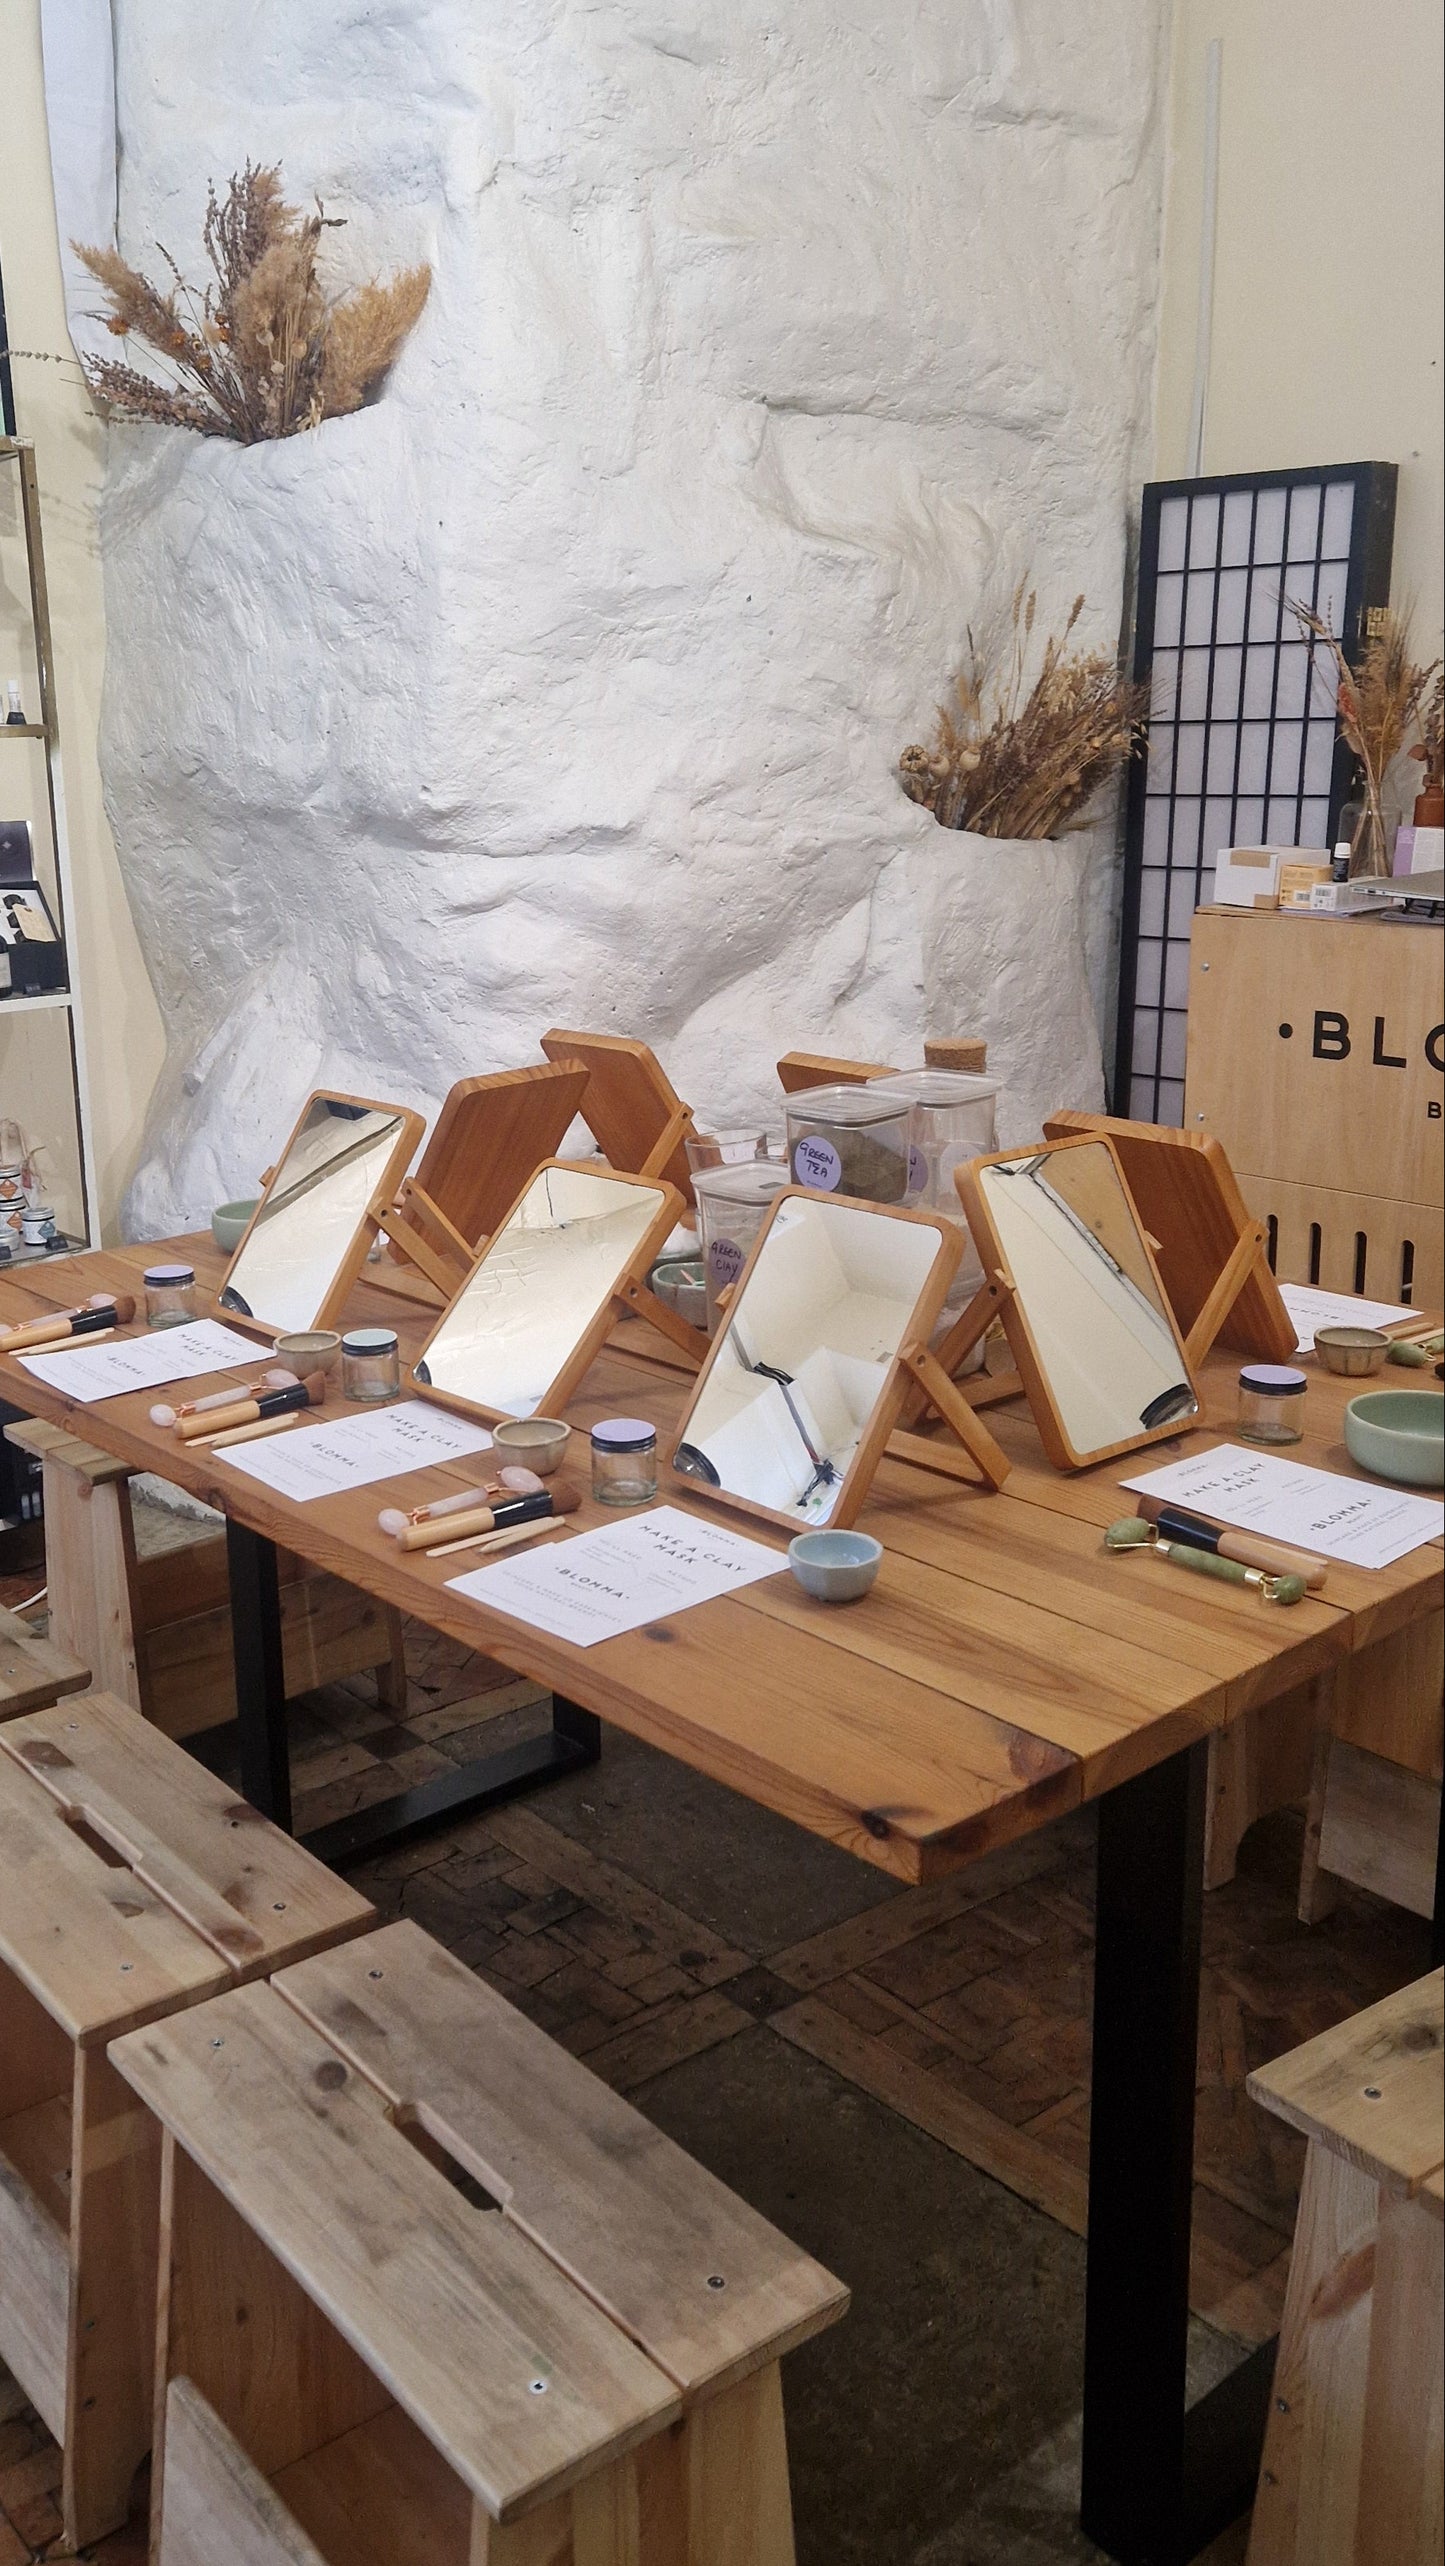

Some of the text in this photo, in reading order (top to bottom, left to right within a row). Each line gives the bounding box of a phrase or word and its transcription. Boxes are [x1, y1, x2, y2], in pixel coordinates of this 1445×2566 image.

[799, 1142, 834, 1165] GREEN
[806, 1159, 828, 1178] TEA
[711, 1241, 740, 1259] GREEN
[386, 1414, 419, 1429] MAKE
[391, 1427, 425, 1442] MASK
[1182, 1481, 1220, 1498] MAKE
[1232, 1462, 1265, 1477] CLAY
[1223, 1477, 1260, 1493] MASK
[638, 1525, 683, 1545] MAKE
[703, 1553, 747, 1572] CLAY
[653, 1544, 699, 1564] MASK
